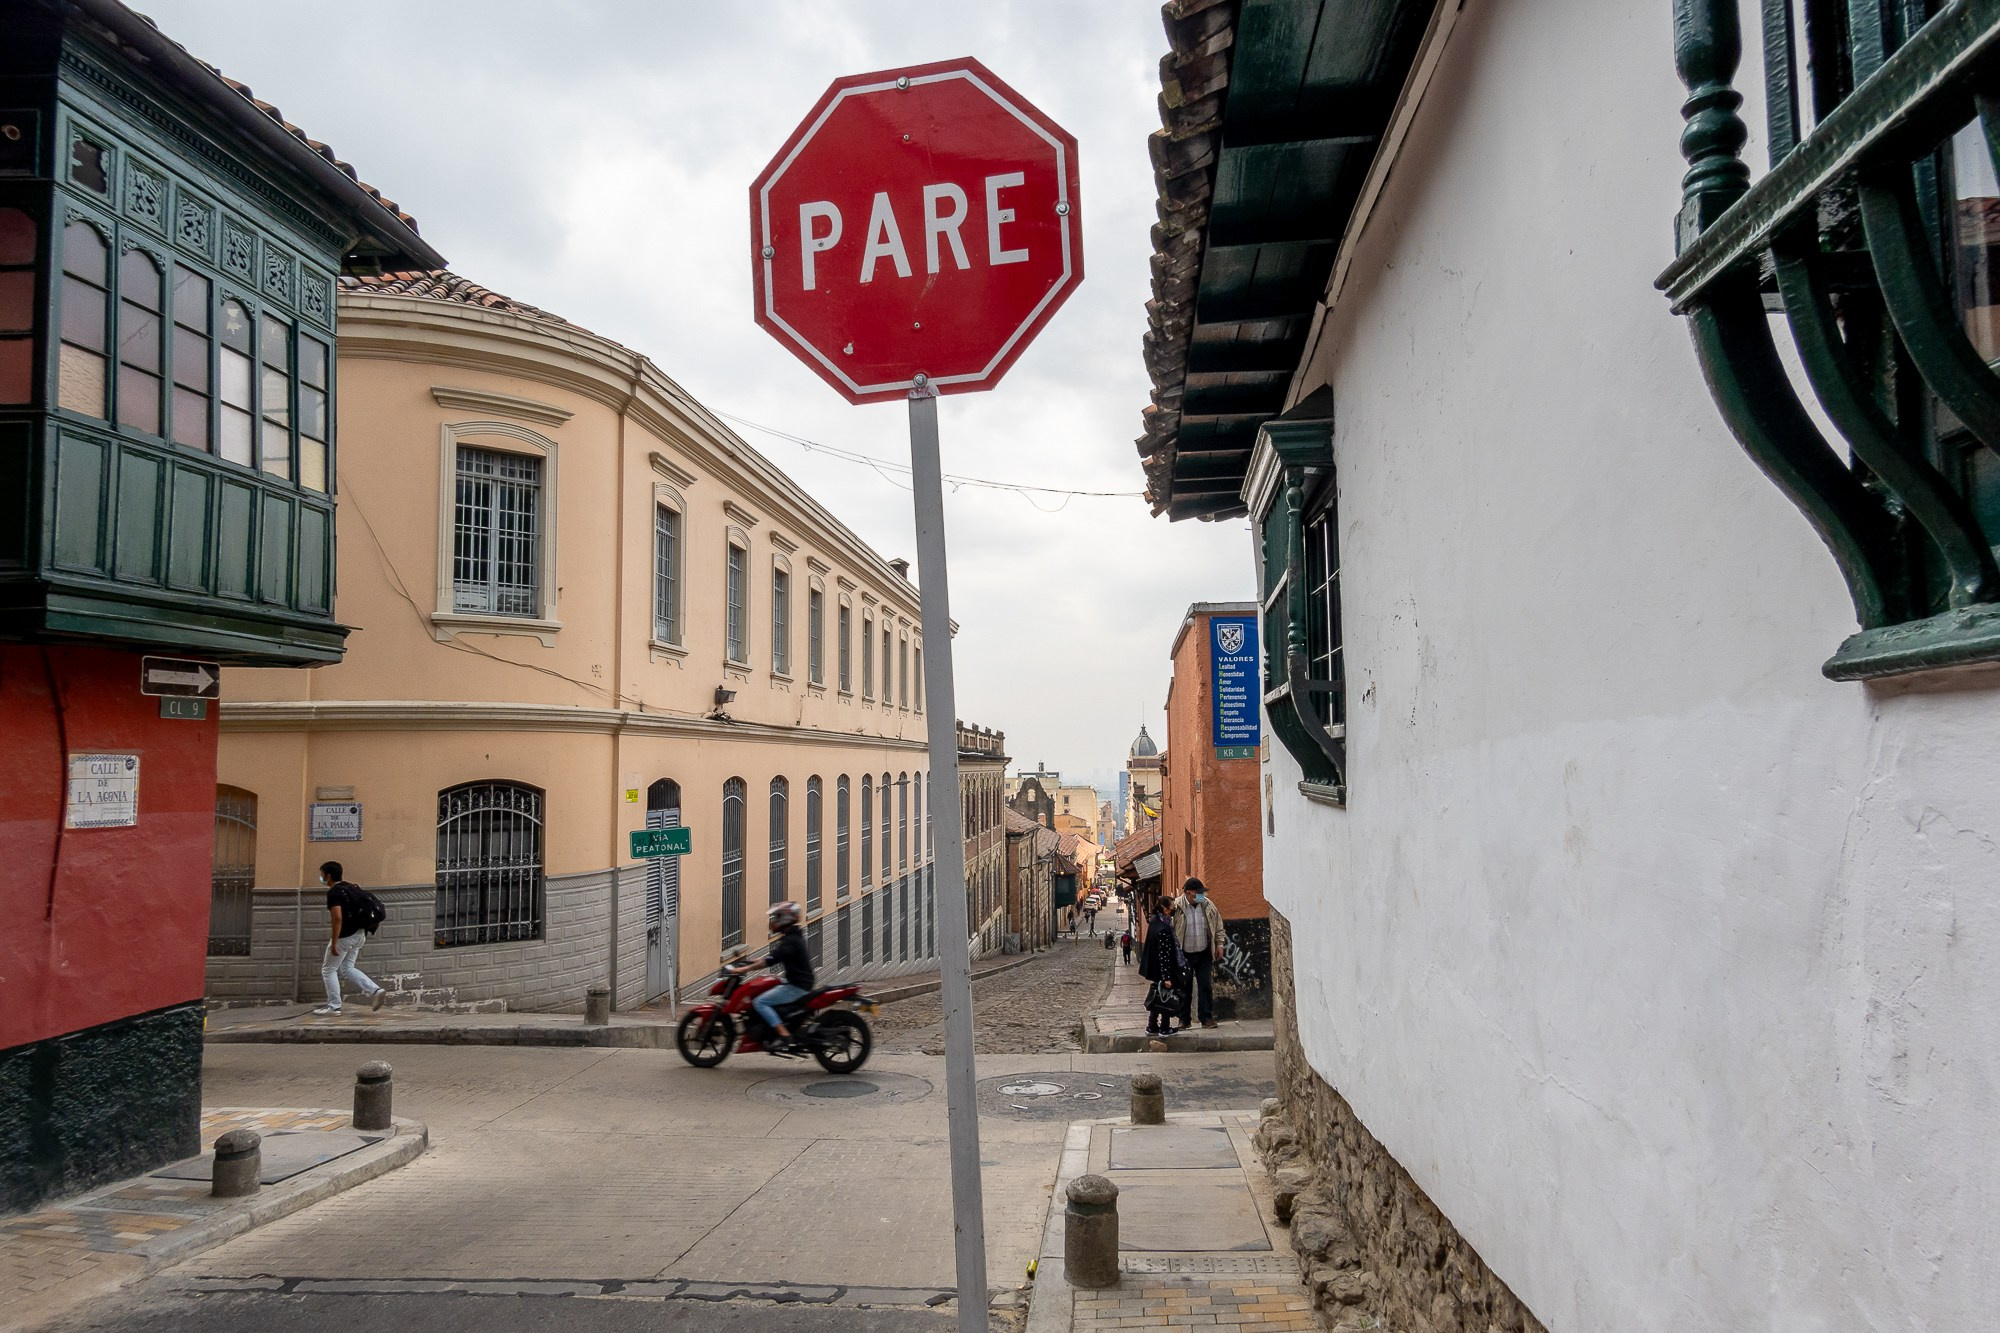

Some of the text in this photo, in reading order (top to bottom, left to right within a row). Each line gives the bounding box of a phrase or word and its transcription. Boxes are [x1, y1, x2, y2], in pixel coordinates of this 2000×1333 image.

[800, 171, 1029, 291] PARE
[169, 701, 199, 716] CL 9
[1220, 731, 1250, 739] Compromiso
[1223, 748, 1249, 757] KR 4
[91, 763, 119, 774] CALLE
[77, 791, 93, 803] LA
[636, 843, 686, 854] PEATONAL
